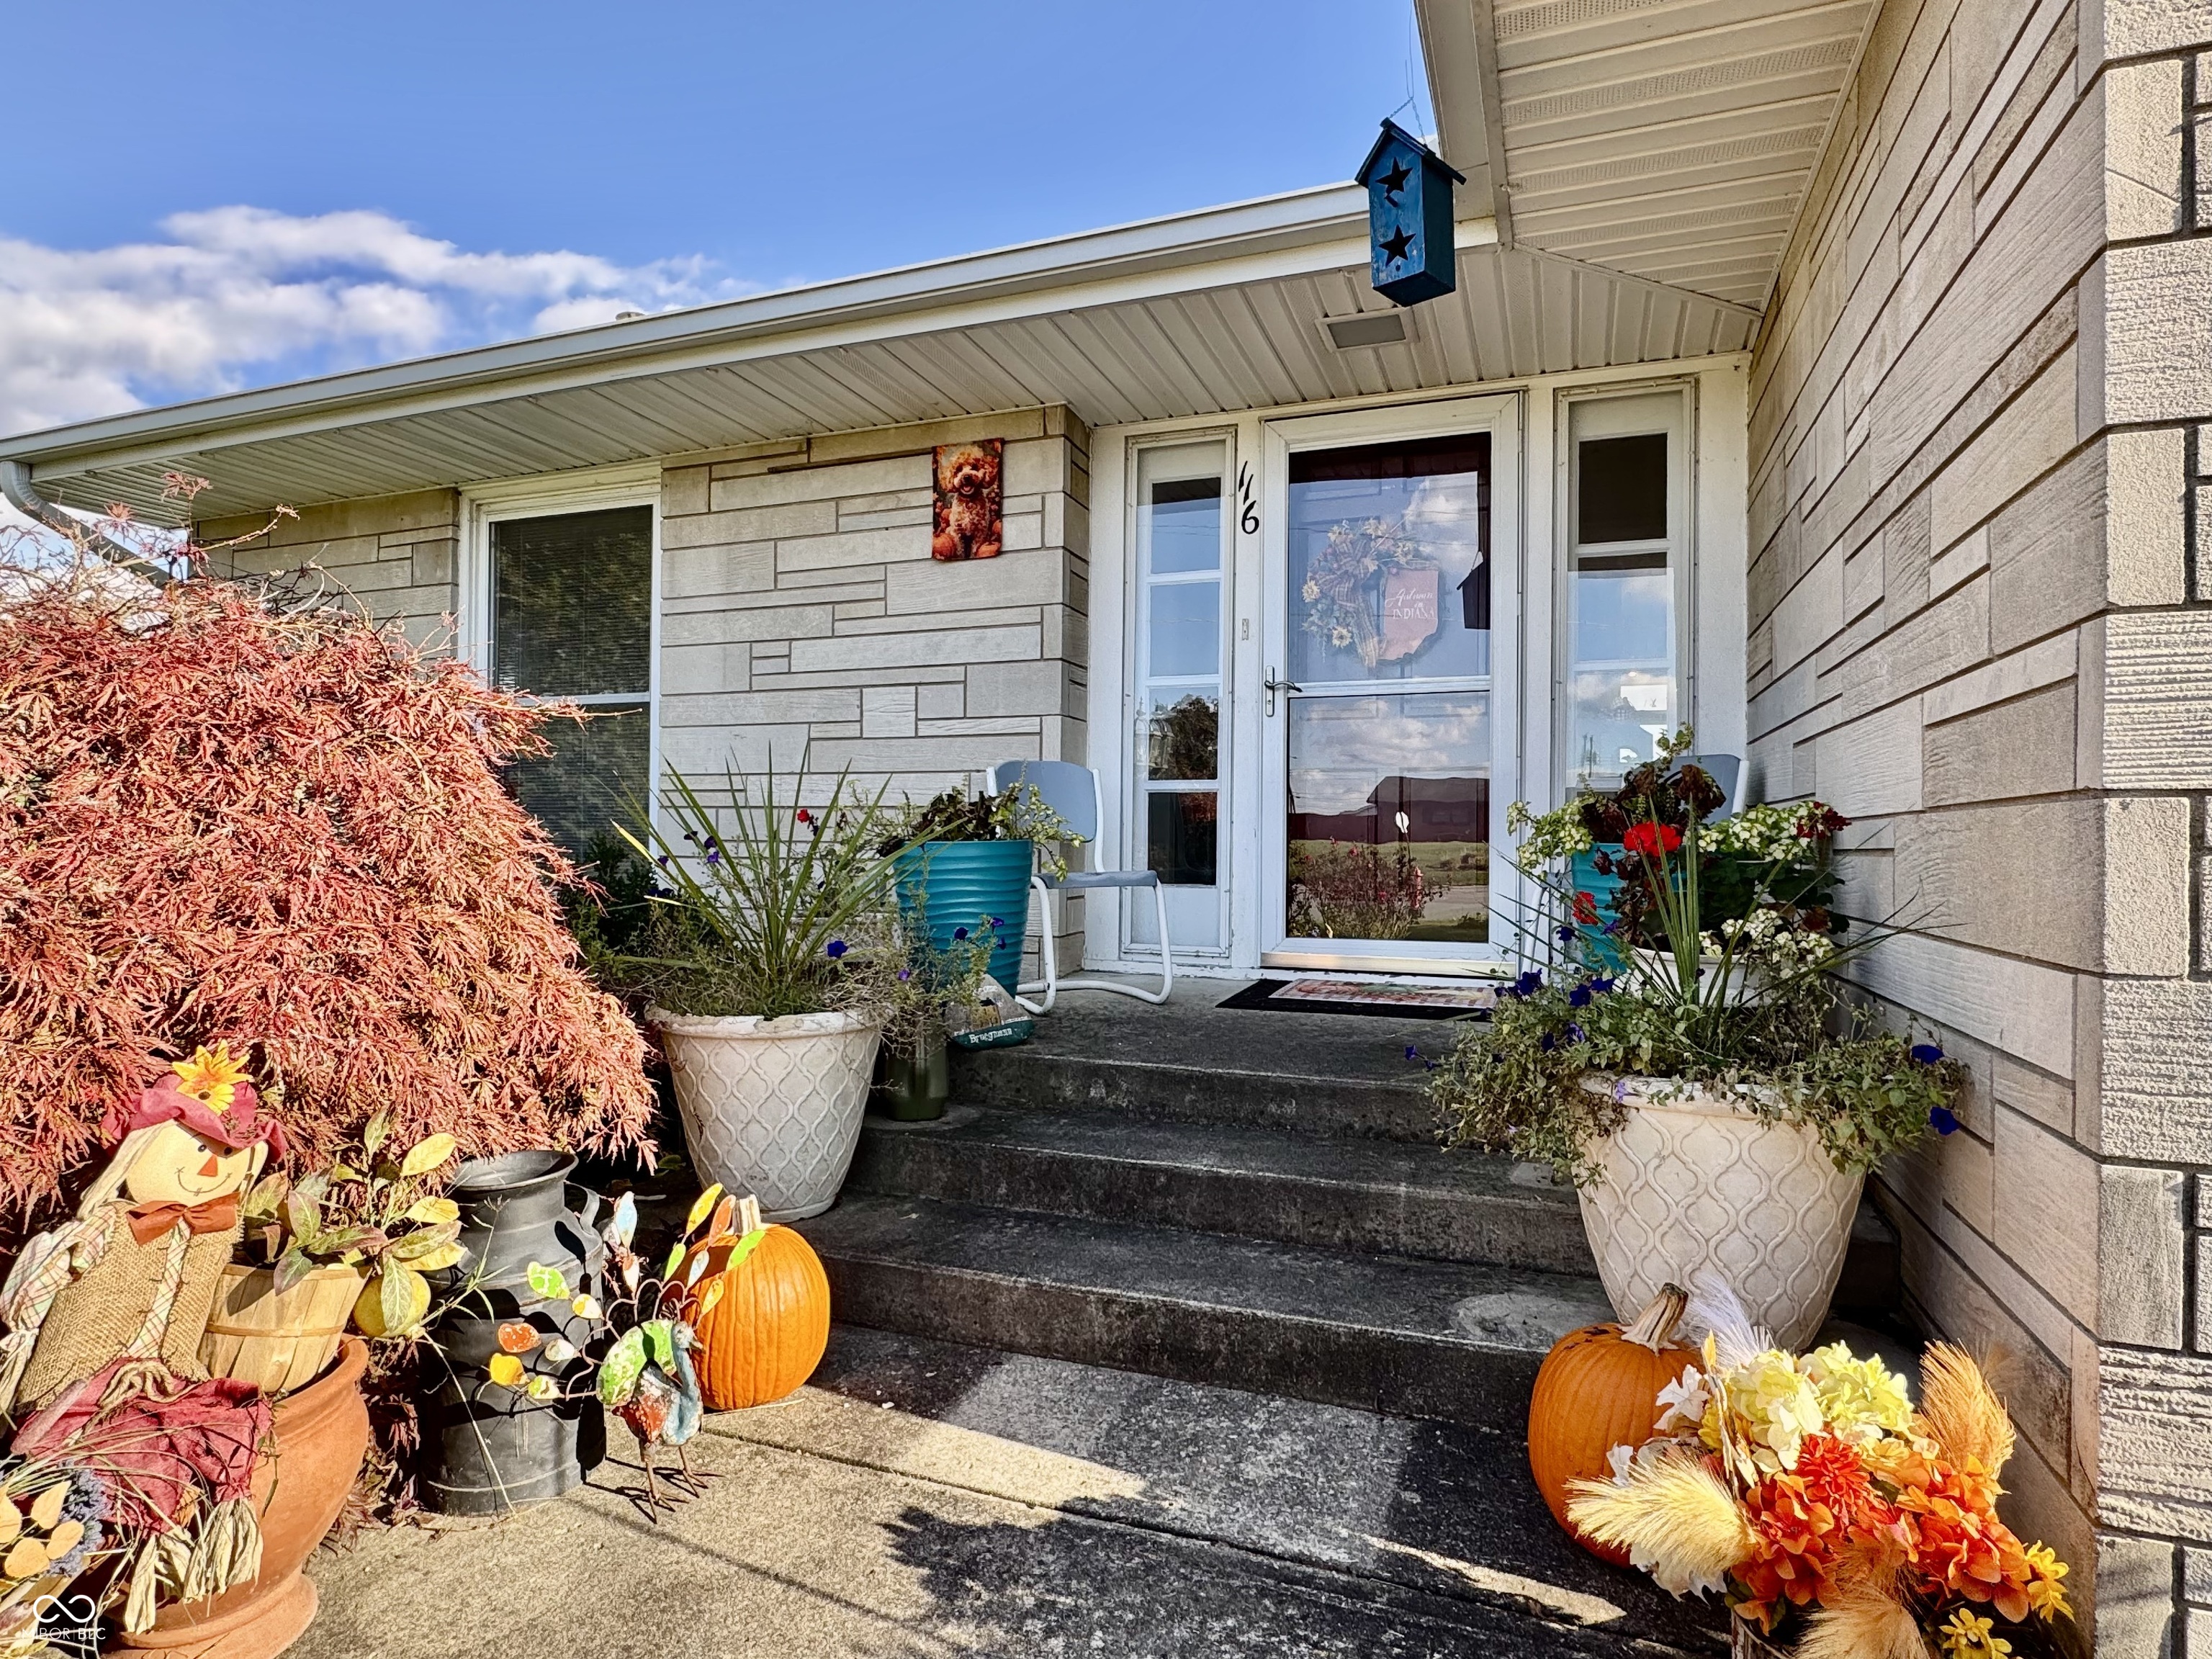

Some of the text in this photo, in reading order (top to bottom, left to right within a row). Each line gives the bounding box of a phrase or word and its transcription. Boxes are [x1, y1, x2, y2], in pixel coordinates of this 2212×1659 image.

[1238, 460, 1259, 534] 116
[1385, 588, 1433, 607] Autumn
[1393, 607, 1434, 620] INDIANA
